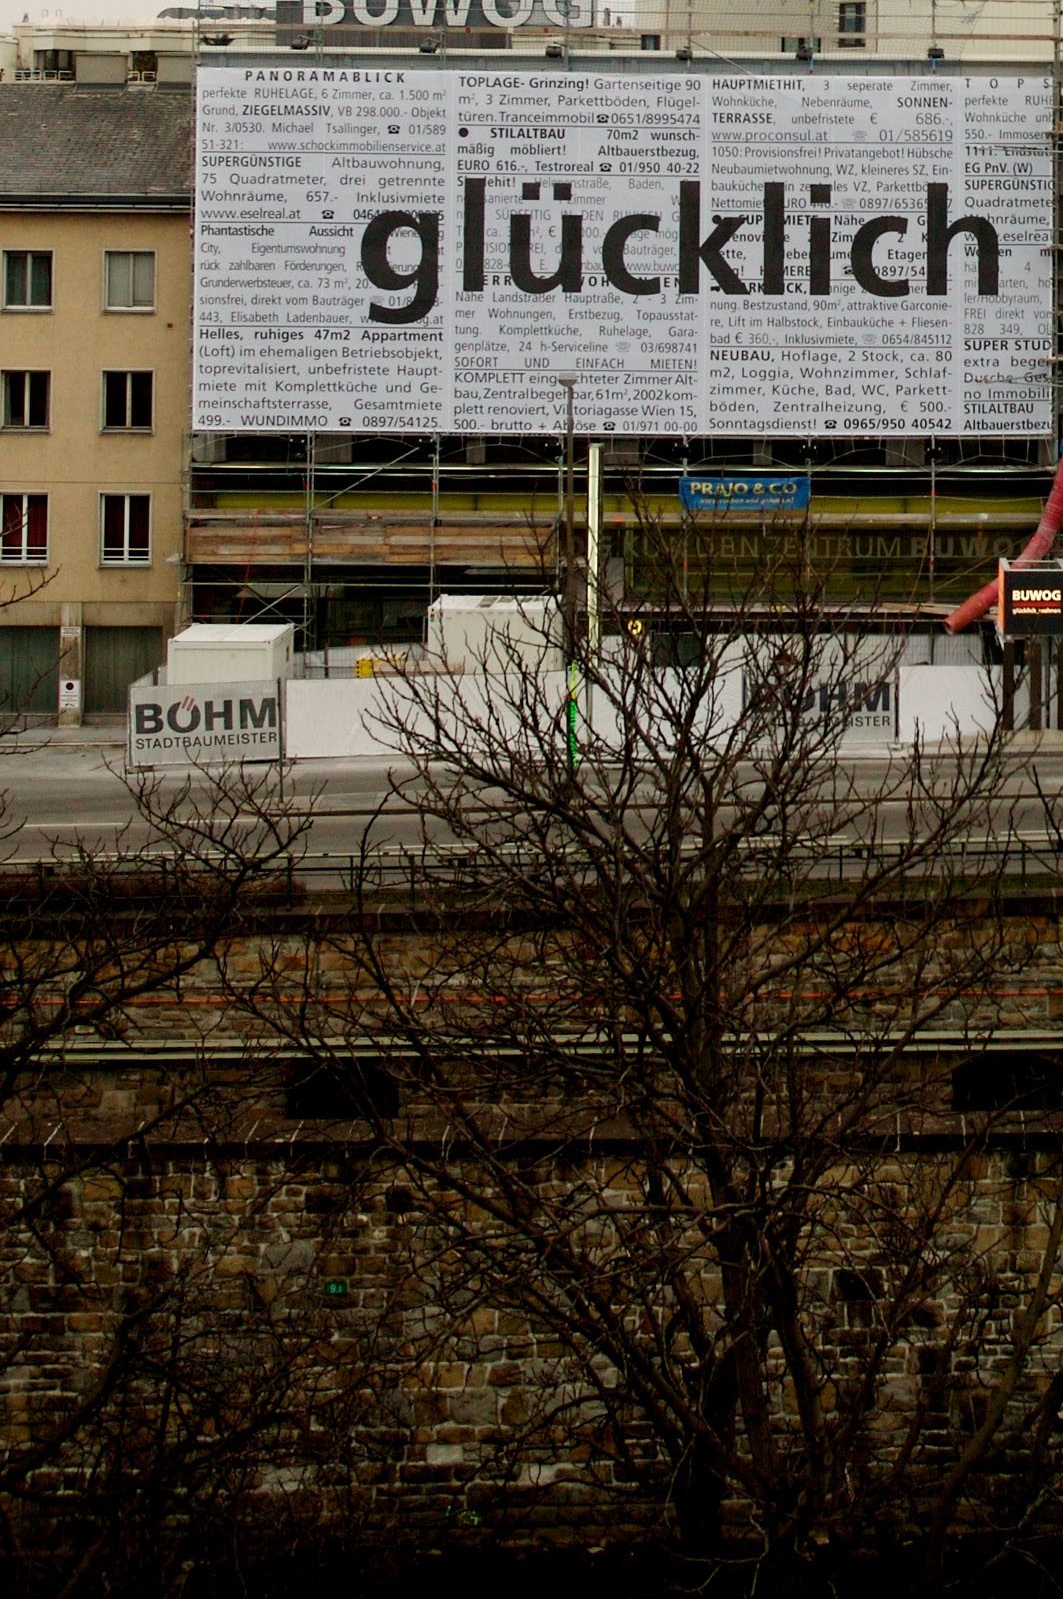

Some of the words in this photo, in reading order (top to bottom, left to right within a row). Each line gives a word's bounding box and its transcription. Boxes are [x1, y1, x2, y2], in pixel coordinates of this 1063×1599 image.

[245, 71, 404, 83] PANORAMABLICK
[459, 76, 525, 89] TOPLAGE-
[529, 77, 589, 92] Grinzing!
[594, 78, 681, 93] Gartenseitige
[685, 79, 701, 91] 90
[713, 79, 805, 92] HAUPTMIETHIT,
[824, 79, 829, 91] 3
[847, 80, 893, 94] seperate
[911, 80, 952, 93] Zimmer,
[712, 96, 777, 109] Wohnküche,
[802, 96, 872, 110] Nebenräume,
[897, 97, 952, 108] SONNEN-
[490, 128, 565, 140] STILALTBAU
[607, 129, 638, 140] 70m2
[651, 129, 700, 141] wunsch-
[712, 130, 828, 145] www.proconsul.at
[457, 144, 494, 158] mäßig
[510, 144, 566, 156] möbliert!
[598, 145, 699, 160] Altbauerstbezug,
[202, 153, 301, 168] SUPERGÜNSTIGE
[331, 157, 444, 172] Altbauwohnung,
[458, 160, 490, 171] EURO
[535, 161, 593, 172] Testroreal
[619, 161, 660, 173] 01/950
[666, 162, 699, 174] 40-22
[965, 162, 980, 174] EG
[1013, 162, 1033, 176] (W)
[202, 173, 217, 185] 75
[230, 173, 326, 188] Quadratmeter,
[340, 174, 365, 186] drei
[378, 175, 445, 189] getrennte
[201, 190, 287, 204] Wohnräume,
[306, 191, 338, 203] 657.-
[357, 191, 445, 204] Inklusivmiete
[361, 179, 998, 325] glücklich
[200, 328, 243, 342] Helles,
[254, 329, 304, 343] ruhiges
[314, 329, 350, 341] 47m2
[361, 329, 443, 344] Appartment
[455, 325, 482, 339] tung.
[499, 325, 582, 339] Komplettküche,
[599, 326, 651, 340] Ruhelage,
[668, 327, 698, 338] Gara-
[199, 345, 235, 360] (Loft)
[240, 346, 255, 357] im
[259, 346, 338, 361] ehemaligen
[342, 347, 442, 362] Betriebsobjekt,
[710, 350, 774, 363] NEUBAU,
[782, 351, 841, 364] Hoflage,
[848, 351, 855, 362] 2
[862, 351, 903, 364] Stock,
[910, 353, 929, 362] ca.
[936, 351, 952, 362] 80
[198, 363, 300, 378] toprevitalisiert,
[308, 364, 389, 376] unbefristete
[397, 365, 443, 379] Haupt-
[455, 357, 498, 368] SOFORT
[524, 358, 550, 369] UND
[576, 358, 624, 369] EINFACH
[651, 359, 697, 370] MIETEN!
[964, 403, 1034, 414] STILALTBAU
[198, 415, 231, 426] 499.-
[241, 415, 328, 427] WUNDIMMO
[709, 418, 816, 432] Sonntagsdienst!
[844, 418, 905, 429] 0965/950
[911, 418, 952, 429] 40542
[690, 481, 748, 497] PRAJO
[752, 482, 764, 494] &
[1012, 589, 1061, 601] BUWOG
[135, 695, 277, 735] BÖHM
[136, 732, 277, 750] STADTBAUMEISTER
